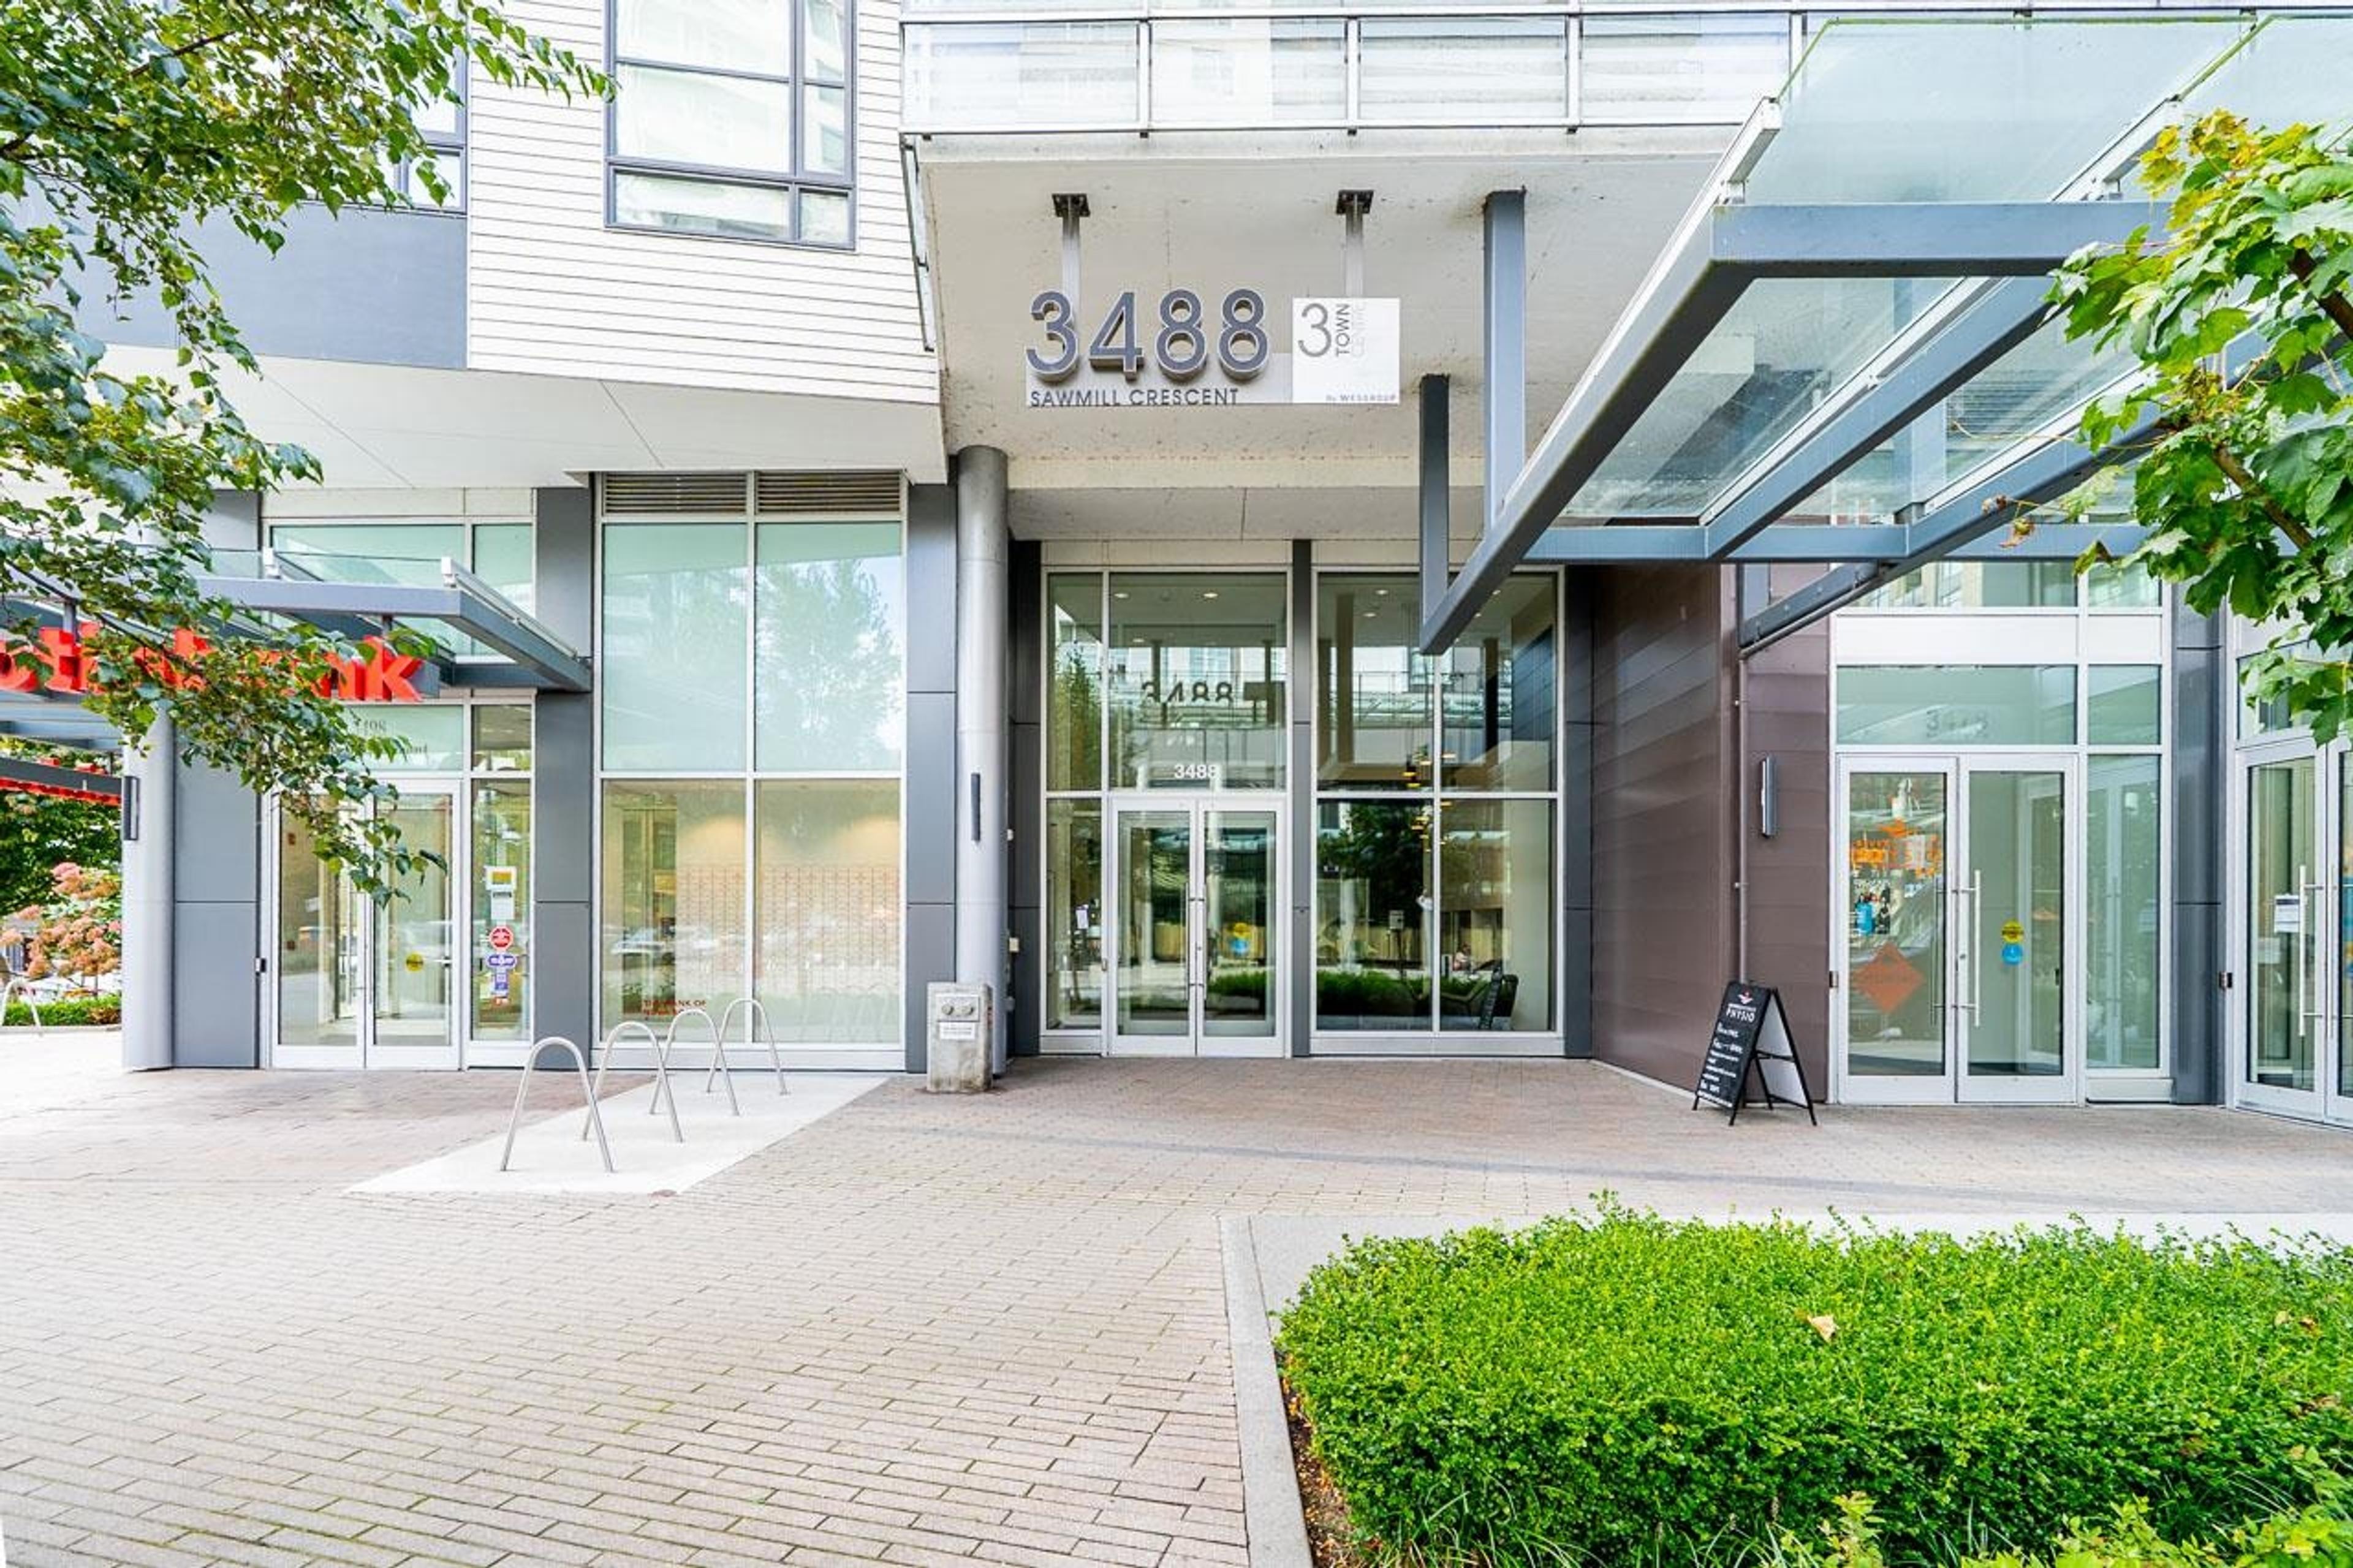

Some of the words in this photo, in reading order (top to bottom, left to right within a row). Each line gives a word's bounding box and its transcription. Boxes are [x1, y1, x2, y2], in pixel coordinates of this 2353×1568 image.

[1026, 288, 1269, 381] 3488
[1298, 303, 1332, 357] 3
[1335, 303, 1350, 357] TOWN
[1030, 388, 1121, 407] SAWMILL
[1129, 388, 1238, 406] CRESCENT
[1174, 764, 1218, 779] 3488
